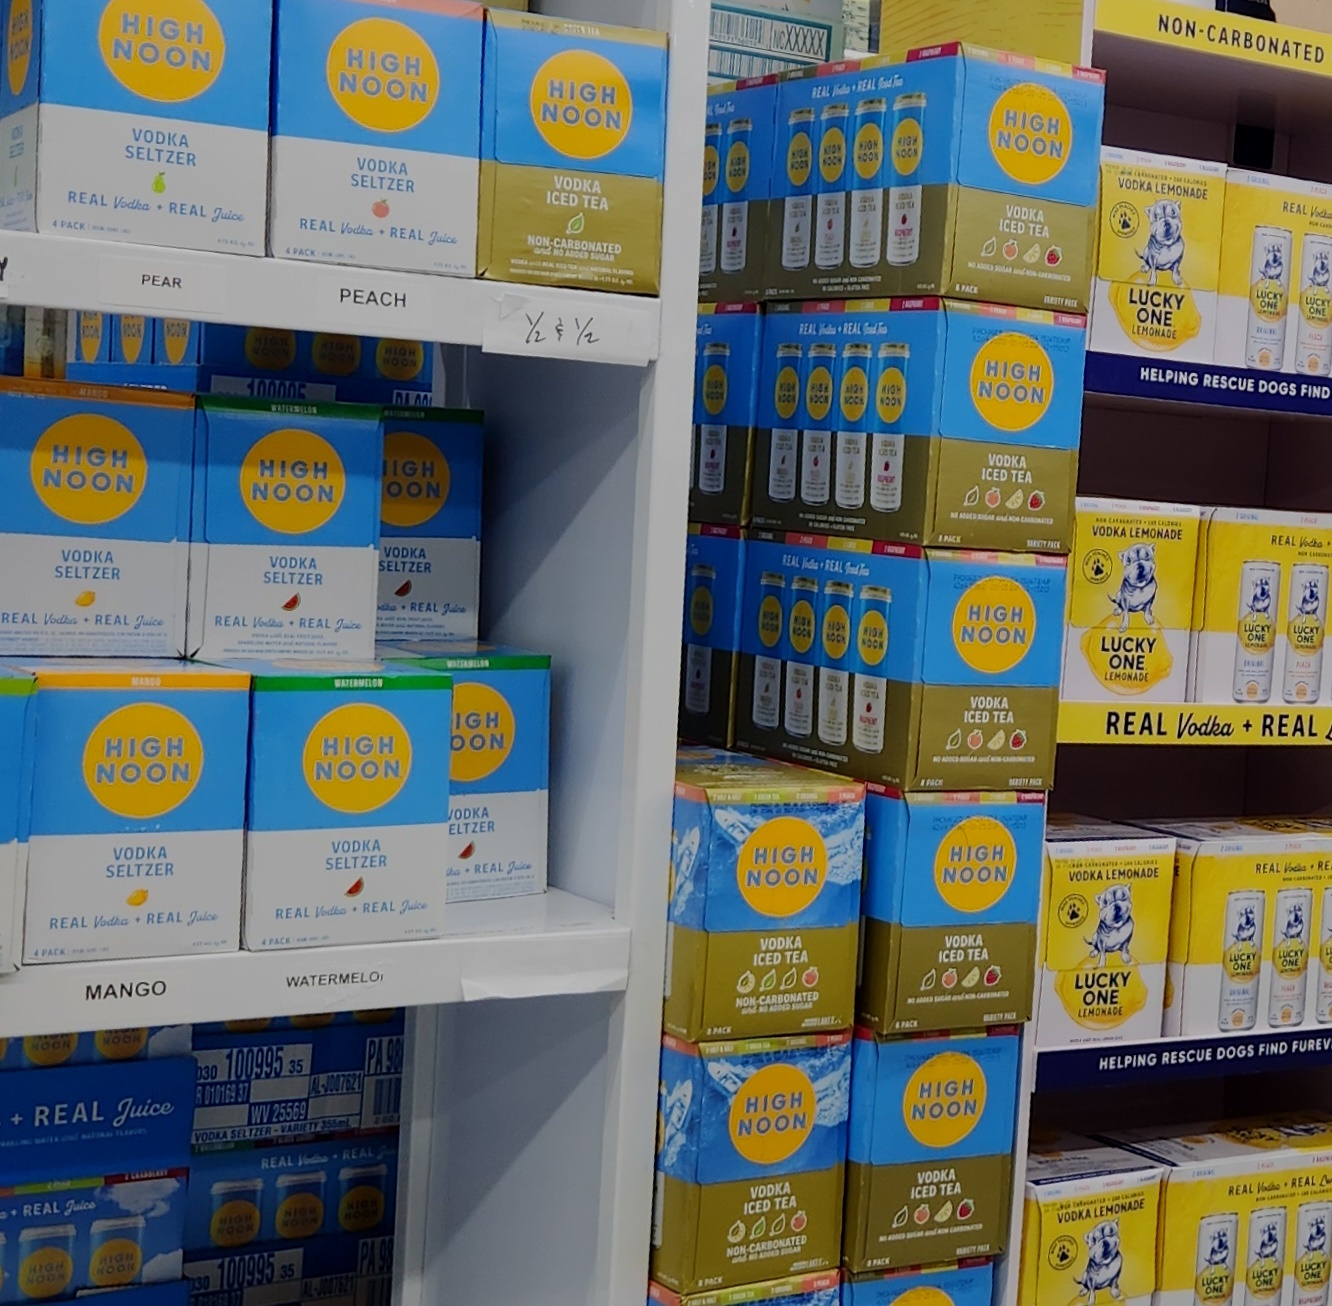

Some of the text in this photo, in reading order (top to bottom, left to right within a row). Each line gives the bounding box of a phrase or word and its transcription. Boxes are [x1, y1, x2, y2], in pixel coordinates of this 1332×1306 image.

[121, 12, 205, 44] HIGH
[1157, 14, 1325, 64] NON-CARBONATED
[347, 47, 421, 77] HIGH
[338, 71, 428, 103] NOON
[998, 132, 1063, 158] NOON
[124, 146, 197, 166] SELTZER
[1283, 201, 1308, 216] REAL
[999, 219, 1050, 238] ICED TEA
[141, 274, 182, 289] PEAR
[340, 288, 407, 308] PEACH
[1129, 288, 1185, 309] LUCKY
[1131, 324, 1177, 340] LEMONADE
[1140, 367, 1199, 387] HELPING
[1203, 373, 1254, 393] RESCUE
[1258, 379, 1297, 397] DOGS
[1300, 383, 1331, 400] FIND
[51, 445, 129, 469] HIGH
[42, 470, 135, 495] NOON
[54, 565, 121, 581] SELTZER
[263, 571, 323, 586] SELTZER
[968, 604, 1023, 622] HIGH
[961, 626, 1027, 644] NOON
[1101, 637, 1157, 655] LUCKY
[1104, 669, 1150, 683] LEMONADE
[1106, 711, 1167, 736] REAL
[1176, 712, 1235, 740] Vodka
[1261, 714, 1318, 737] REAL
[322, 736, 395, 756] HIGH
[315, 760, 401, 781] NOON
[113, 847, 167, 861] VODKA
[331, 840, 382, 854] VODKA
[755, 847, 814, 865] HIGH
[106, 863, 174, 878] SELTZER
[325, 855, 387, 871] SELTZER
[747, 868, 818, 887] NOON
[286, 971, 384, 988] WATERMELO
[1075, 971, 1131, 991] LUCKY
[85, 980, 167, 1001] MANGO
[1077, 1005, 1124, 1019] LEMONADE
[226, 1047, 303, 1079] 100995 35
[1099, 1052, 1157, 1071] HELPING
[1161, 1048, 1213, 1066] RESCUE
[1216, 1044, 1255, 1061] DOGS
[1258, 1041, 1288, 1055] FIND
[919, 1079, 974, 1098] HIGH
[34, 1098, 174, 1128] REAL Juice
[911, 1100, 977, 1120] NOON
[1057, 1198, 1145, 1224] VODKA LEMONADE
